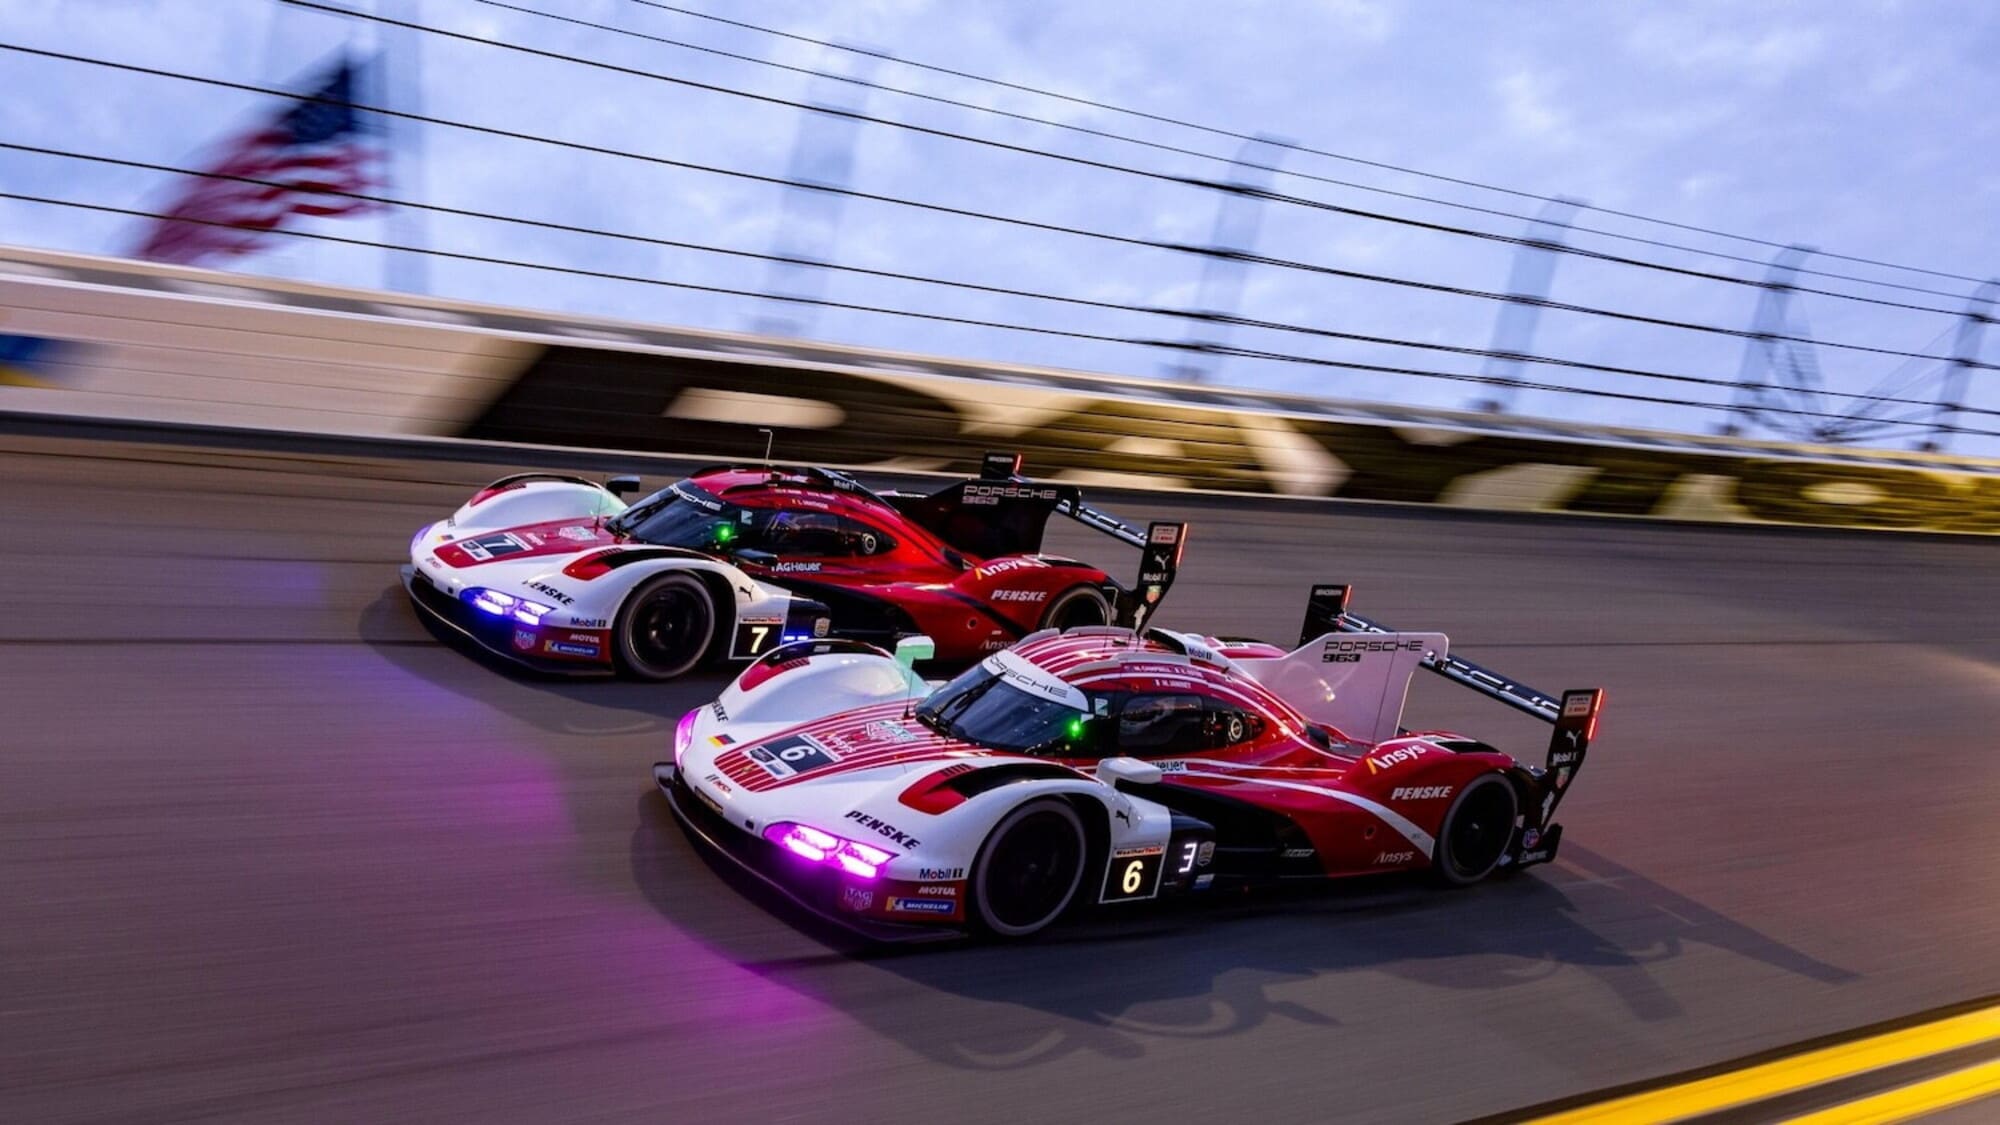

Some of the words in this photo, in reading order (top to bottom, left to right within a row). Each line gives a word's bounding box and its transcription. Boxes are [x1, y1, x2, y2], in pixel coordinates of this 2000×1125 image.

[963, 485, 1057, 499] PORSCHE
[962, 495, 999, 505] 963
[483, 537, 517, 549] 7
[991, 589, 1048, 602] PENSKE
[570, 616, 598, 627] Mobil
[569, 632, 600, 643] MOTUL
[751, 626, 769, 654] 7
[1324, 640, 1425, 652] PORSCHE
[1321, 653, 1361, 663] 963
[779, 745, 817, 762] 6
[1366, 744, 1427, 775] Ansys
[1391, 786, 1453, 800] PENSKE
[844, 810, 921, 850] PENSKE
[1116, 846, 1162, 856] WeatherTech
[1178, 842, 1198, 873] 3
[1371, 850, 1415, 864] Ansys
[919, 867, 951, 880] Mobil
[1122, 859, 1144, 893] 6
[918, 887, 956, 896] MOTUL
[905, 902, 950, 911] MICHELIN
